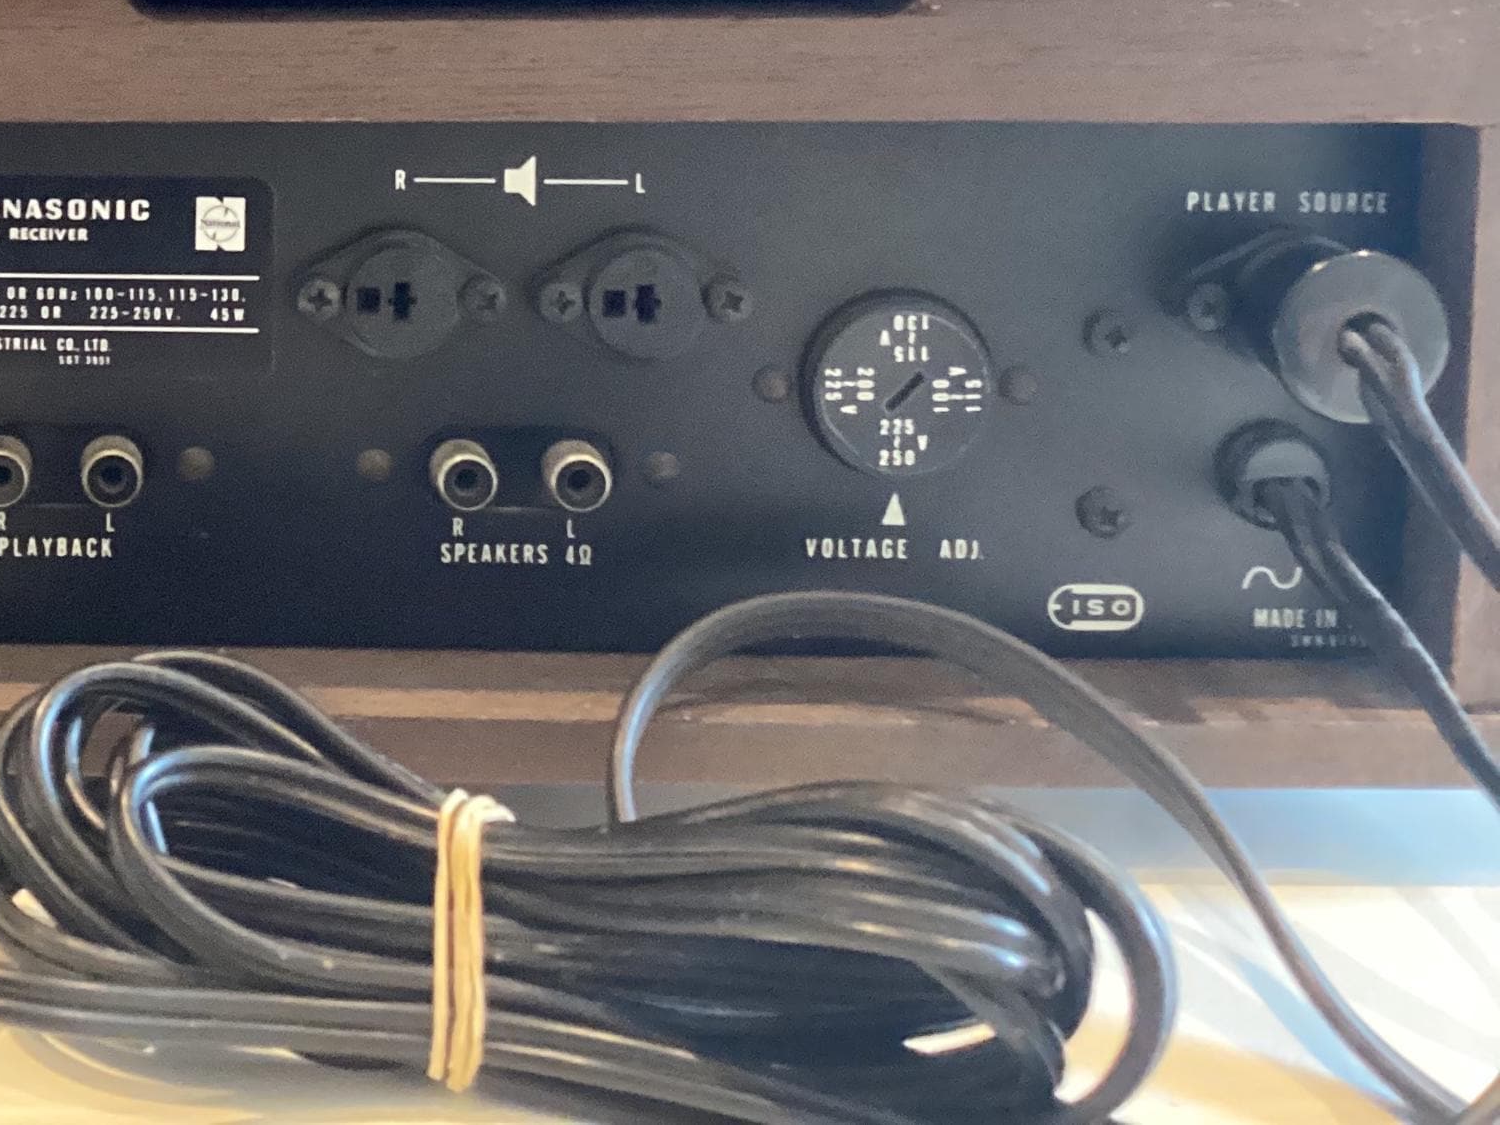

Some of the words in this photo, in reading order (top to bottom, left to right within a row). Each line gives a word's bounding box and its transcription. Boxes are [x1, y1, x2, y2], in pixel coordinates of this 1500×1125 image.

[394, 169, 406, 191] R
[635, 172, 646, 194] L
[1186, 190, 1276, 212] PLAYER
[1297, 190, 1387, 214] SOURCE
[8, 226, 89, 242] RECEIVER
[6, 286, 27, 300] OR
[36, 286, 78, 301] 60Hz
[40, 305, 62, 320] OR
[105, 512, 115, 533] L
[452, 517, 464, 537] R
[566, 518, 576, 539] L
[440, 542, 549, 565] SPEAKERS
[805, 537, 908, 560] VOLTAGE
[1072, 598, 1132, 616] ISO
[1253, 607, 1305, 628] MADE
[1315, 608, 1337, 628] IN
